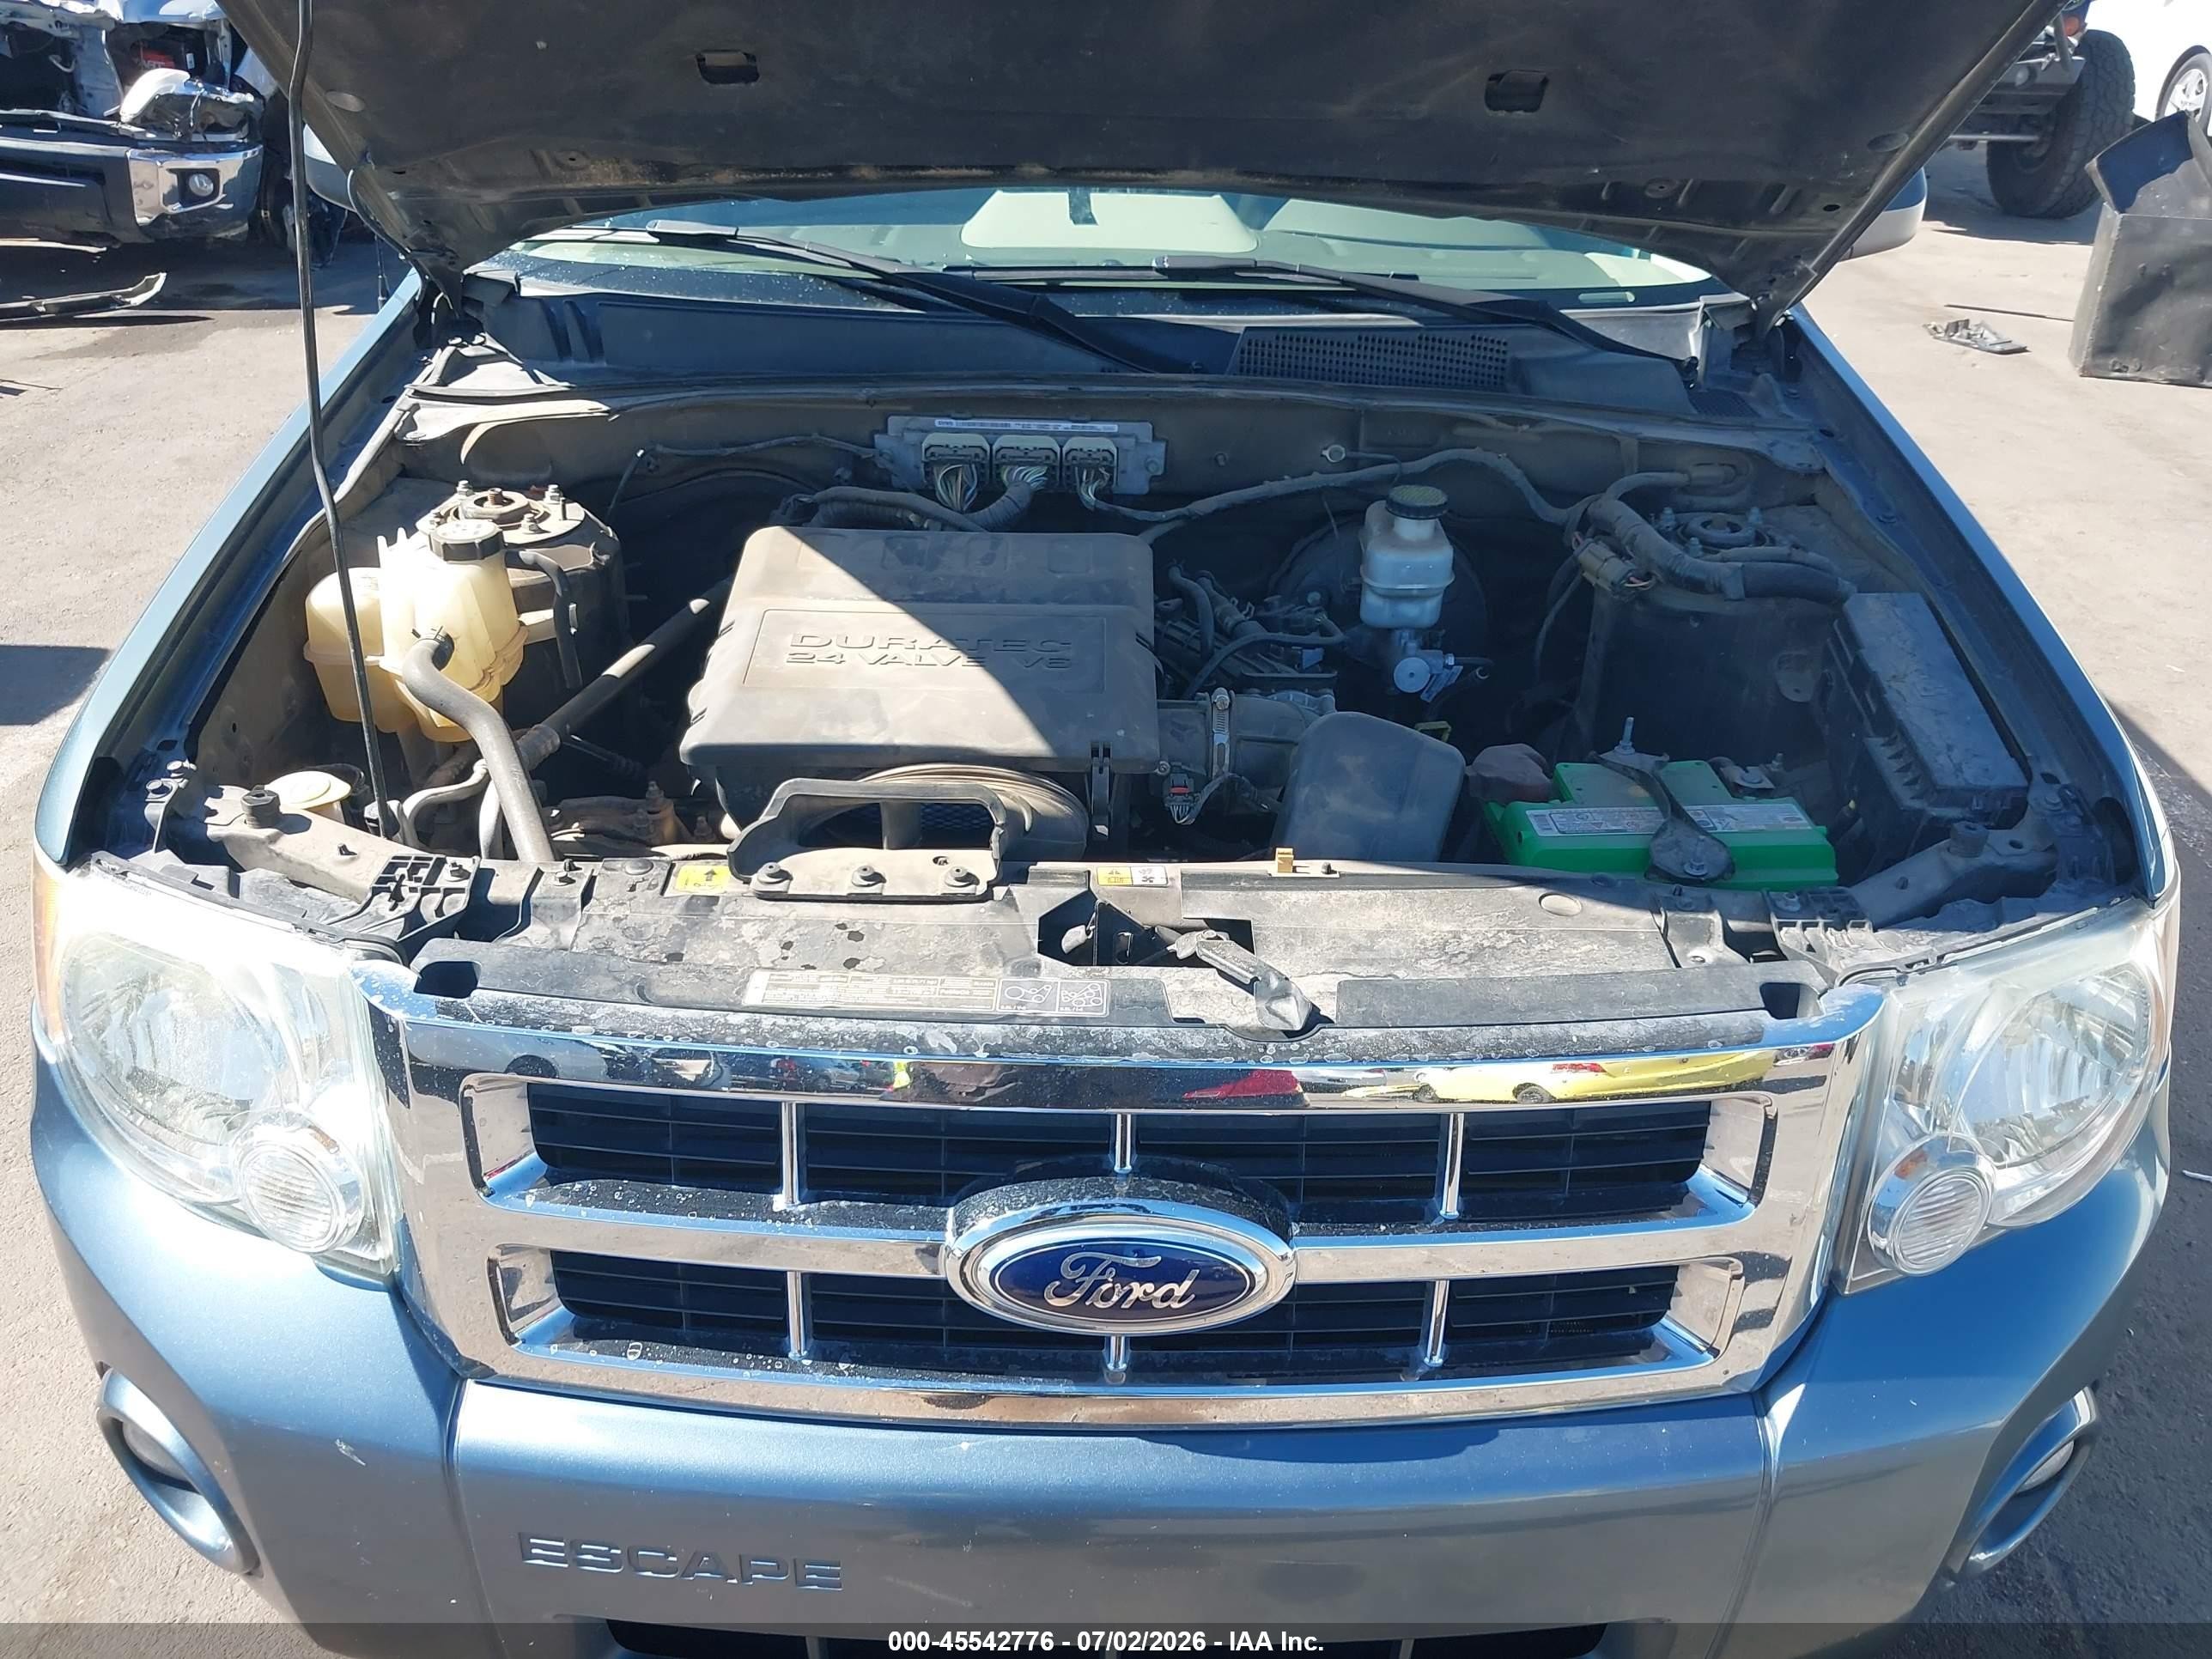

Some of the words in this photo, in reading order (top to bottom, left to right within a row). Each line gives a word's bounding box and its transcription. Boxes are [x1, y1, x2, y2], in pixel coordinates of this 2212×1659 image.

[787, 653, 845, 665] 24
[859, 653, 987, 667] VALVE
[1019, 657, 1073, 669] V6
[791, 634, 1072, 653] DURATEC
[1044, 1251, 1200, 1310] Ford
[519, 1533, 843, 1590] ESCAPE
